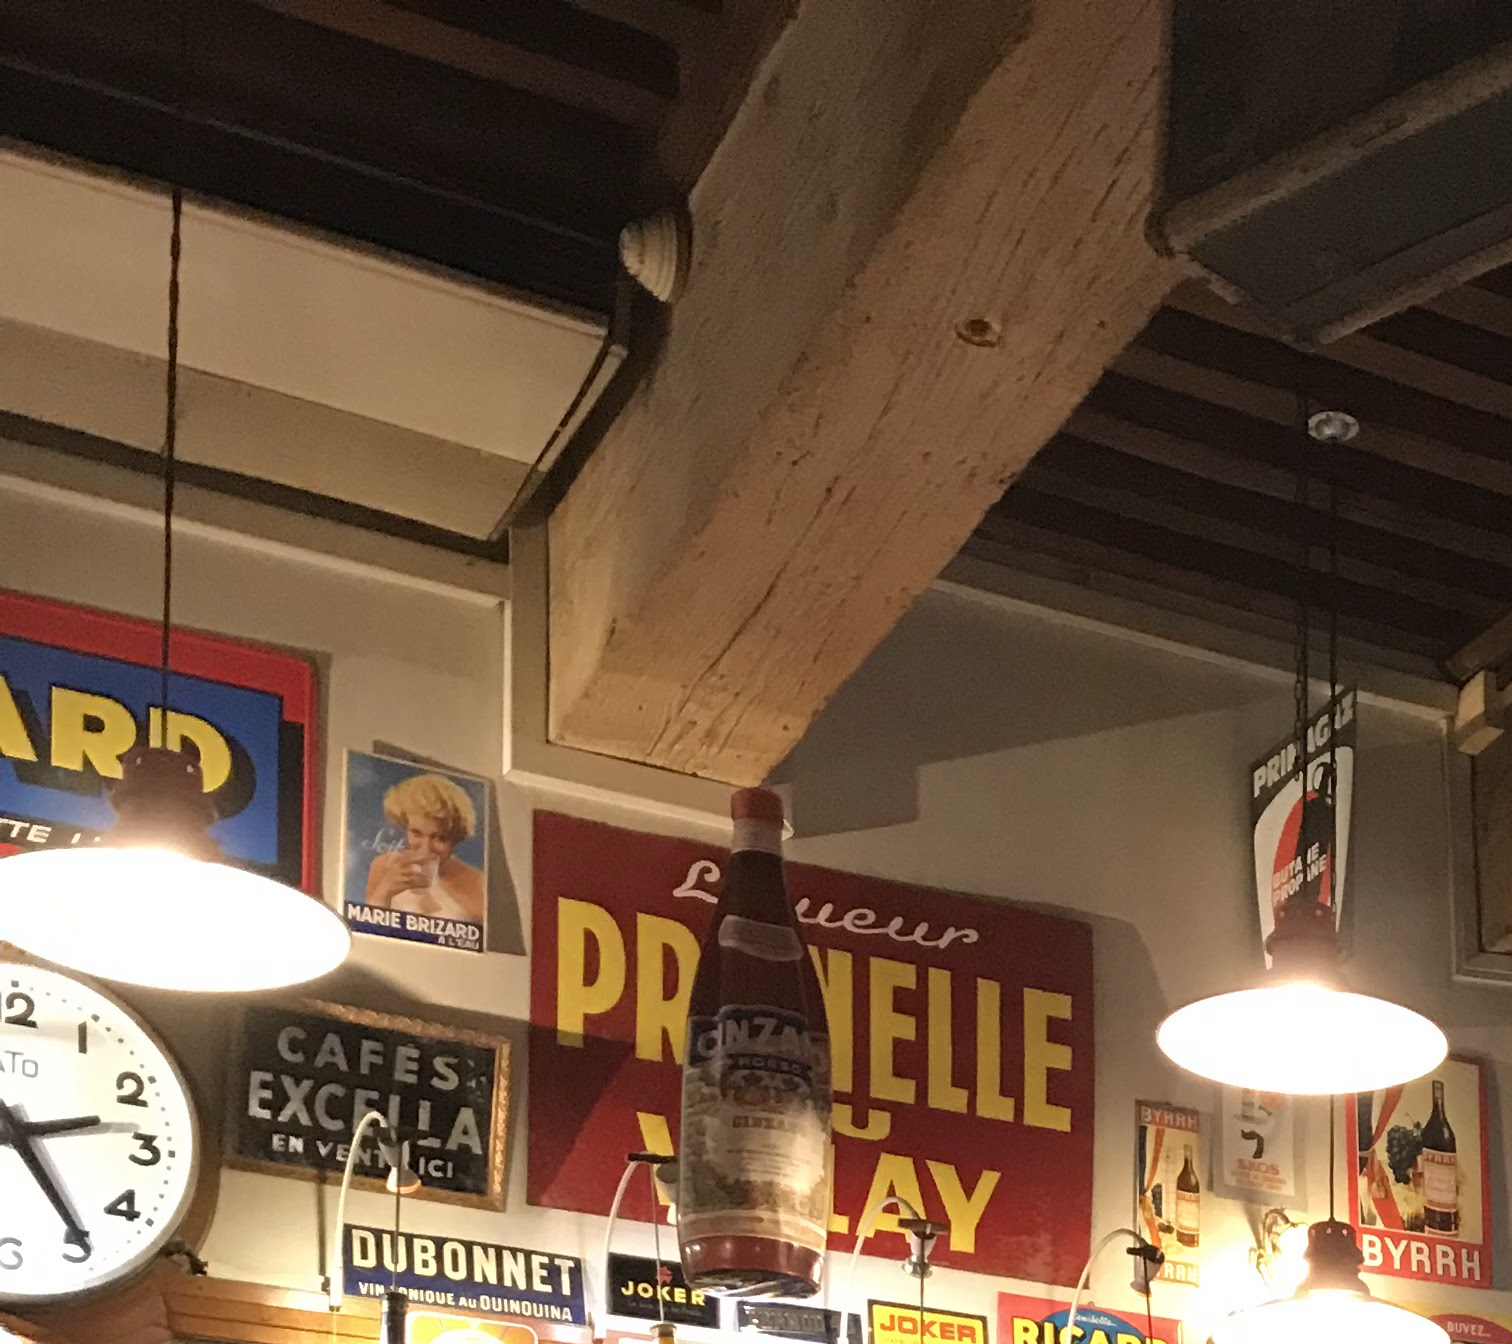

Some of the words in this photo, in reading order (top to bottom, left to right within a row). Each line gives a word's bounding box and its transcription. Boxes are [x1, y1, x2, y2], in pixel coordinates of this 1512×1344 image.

[347, 904, 401, 928] MARIE
[406, 912, 480, 941] BRIZARD
[78, 1022, 88, 1054] 1
[116, 1071, 148, 1107] 2
[1140, 1107, 1198, 1130] BYRRH
[129, 1132, 161, 1166] 3
[272, 1133, 304, 1153] EN
[316, 1140, 388, 1168] VENT
[418, 1157, 453, 1178] ICI
[103, 1190, 141, 1221] 4
[351, 1229, 576, 1296] DUBONNET
[1362, 1234, 1481, 1281] BYRRH
[358, 1281, 381, 1297] VIN
[479, 1295, 573, 1322] QUINQUINA
[621, 1280, 706, 1306] JOKER
[880, 1314, 977, 1344] JOKER
